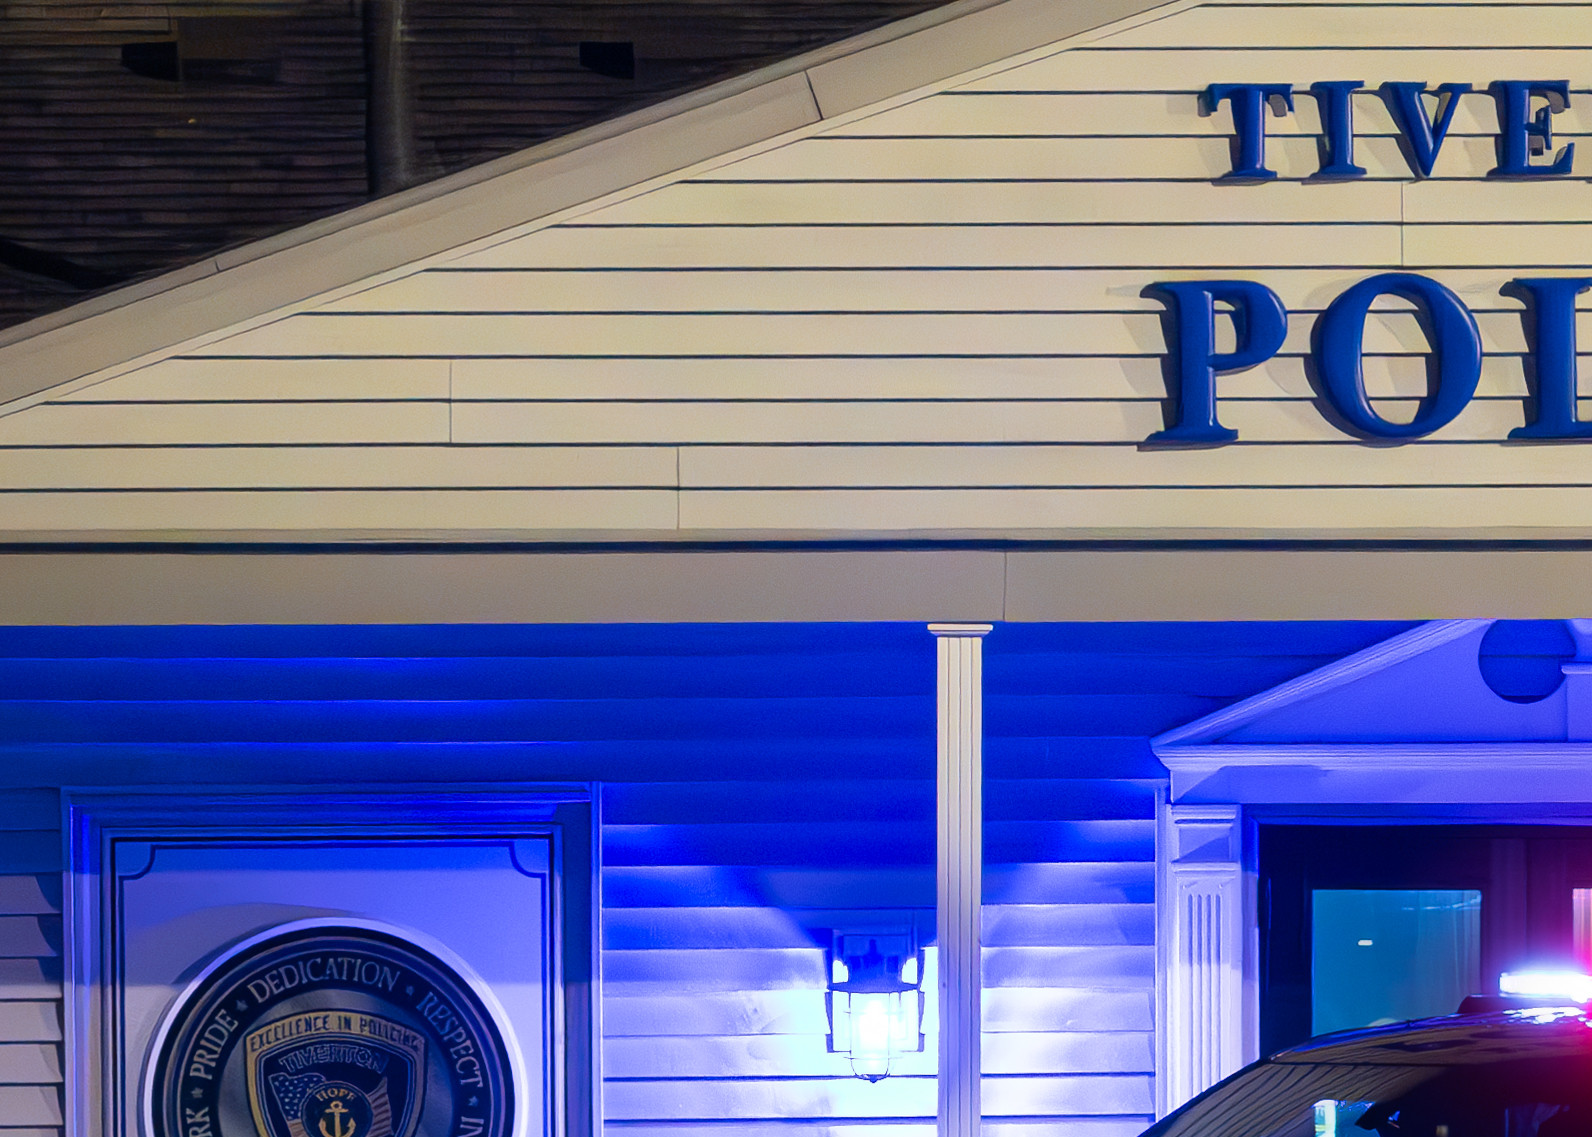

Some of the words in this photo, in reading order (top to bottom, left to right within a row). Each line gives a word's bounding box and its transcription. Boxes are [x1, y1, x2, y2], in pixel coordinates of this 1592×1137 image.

[189, 1009, 239, 1081] PRIDE
[247, 957, 401, 1004] DEDICATION
[415, 991, 485, 1089] RESPECT
[250, 1014, 331, 1051] EXCELLENCE
[338, 1013, 353, 1032] IN
